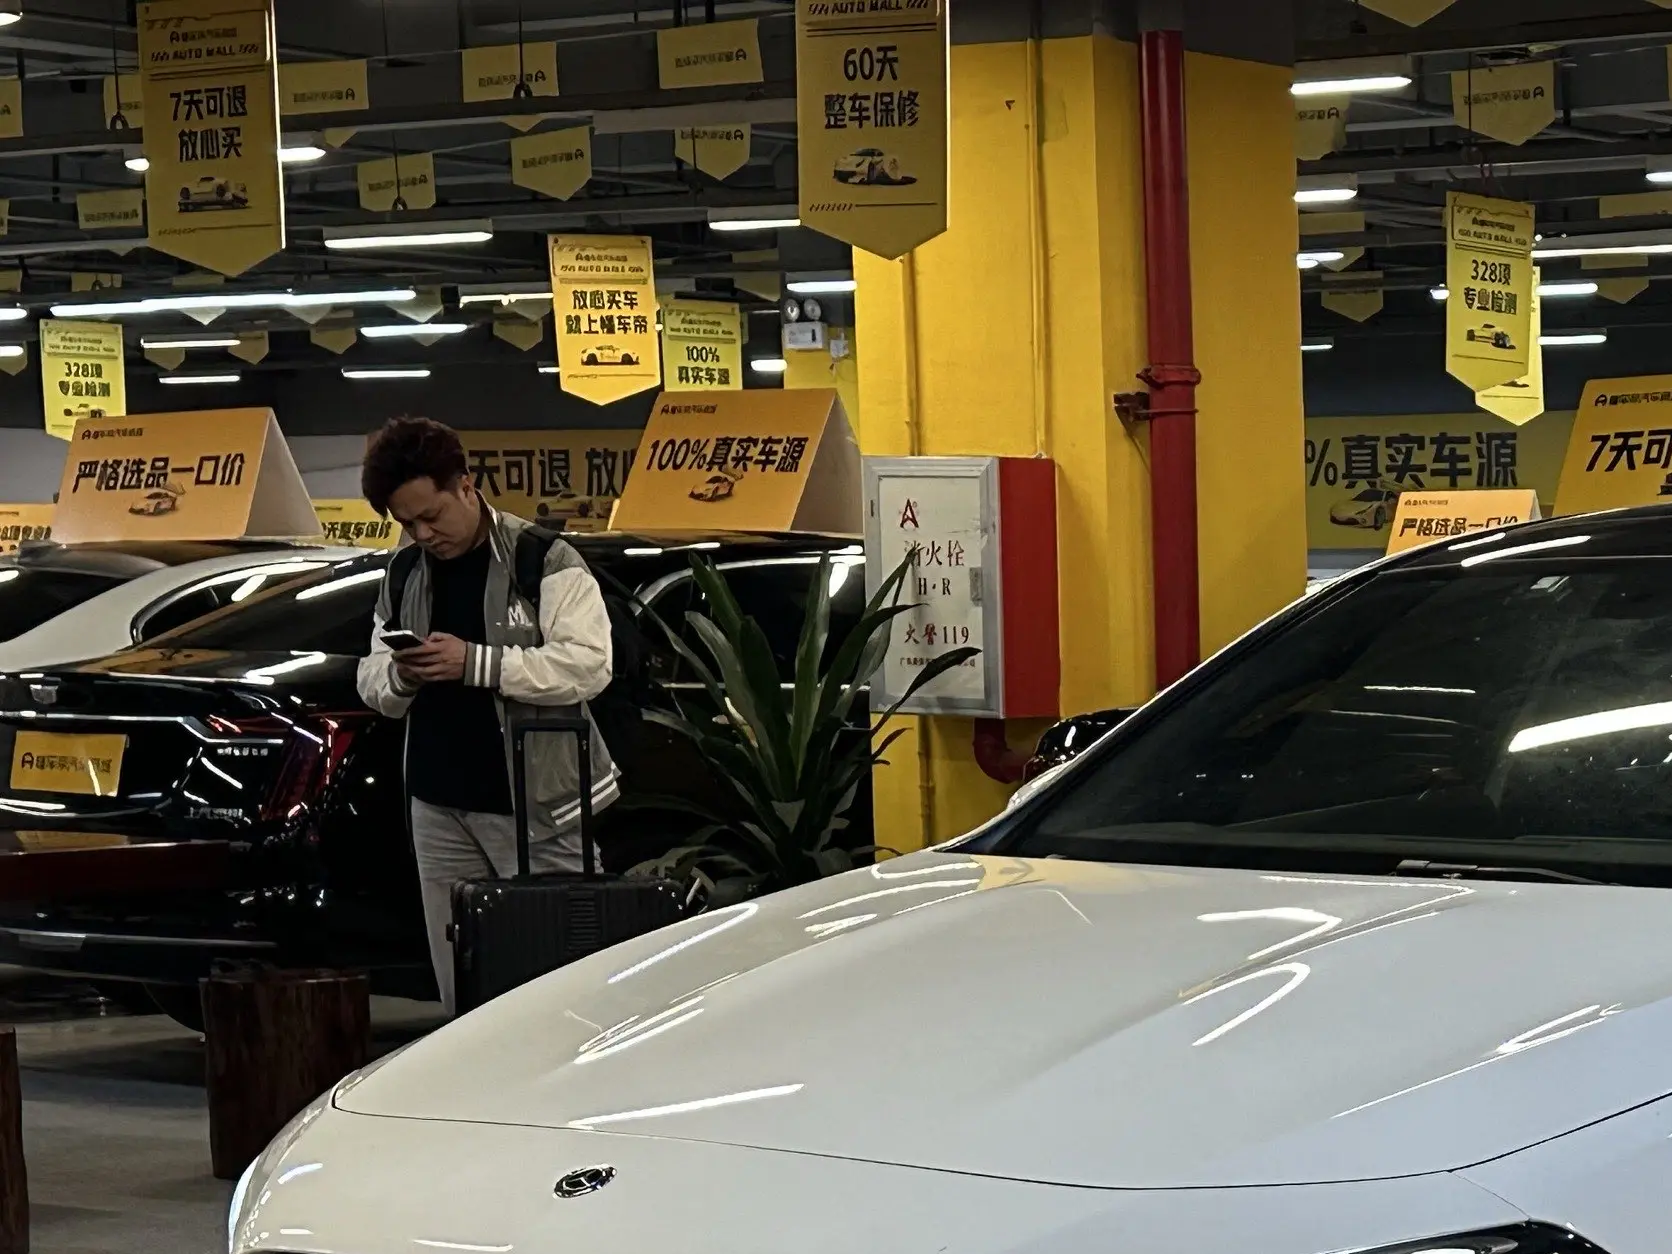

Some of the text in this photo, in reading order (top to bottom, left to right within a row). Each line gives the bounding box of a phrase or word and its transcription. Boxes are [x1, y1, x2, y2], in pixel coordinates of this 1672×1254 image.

[831, 1, 865, 14] AUTO
[843, 45, 899, 82] 60天
[169, 85, 249, 122] 7天可退
[824, 90, 920, 130] 整车保修
[178, 126, 243, 163] 放心买
[1471, 259, 1511, 285] 328项
[572, 289, 639, 310] 放心买车
[686, 346, 720, 363] 100%
[646, 435, 809, 473] 100%真实车源
[72, 452, 245, 494] 严格选品一口价
